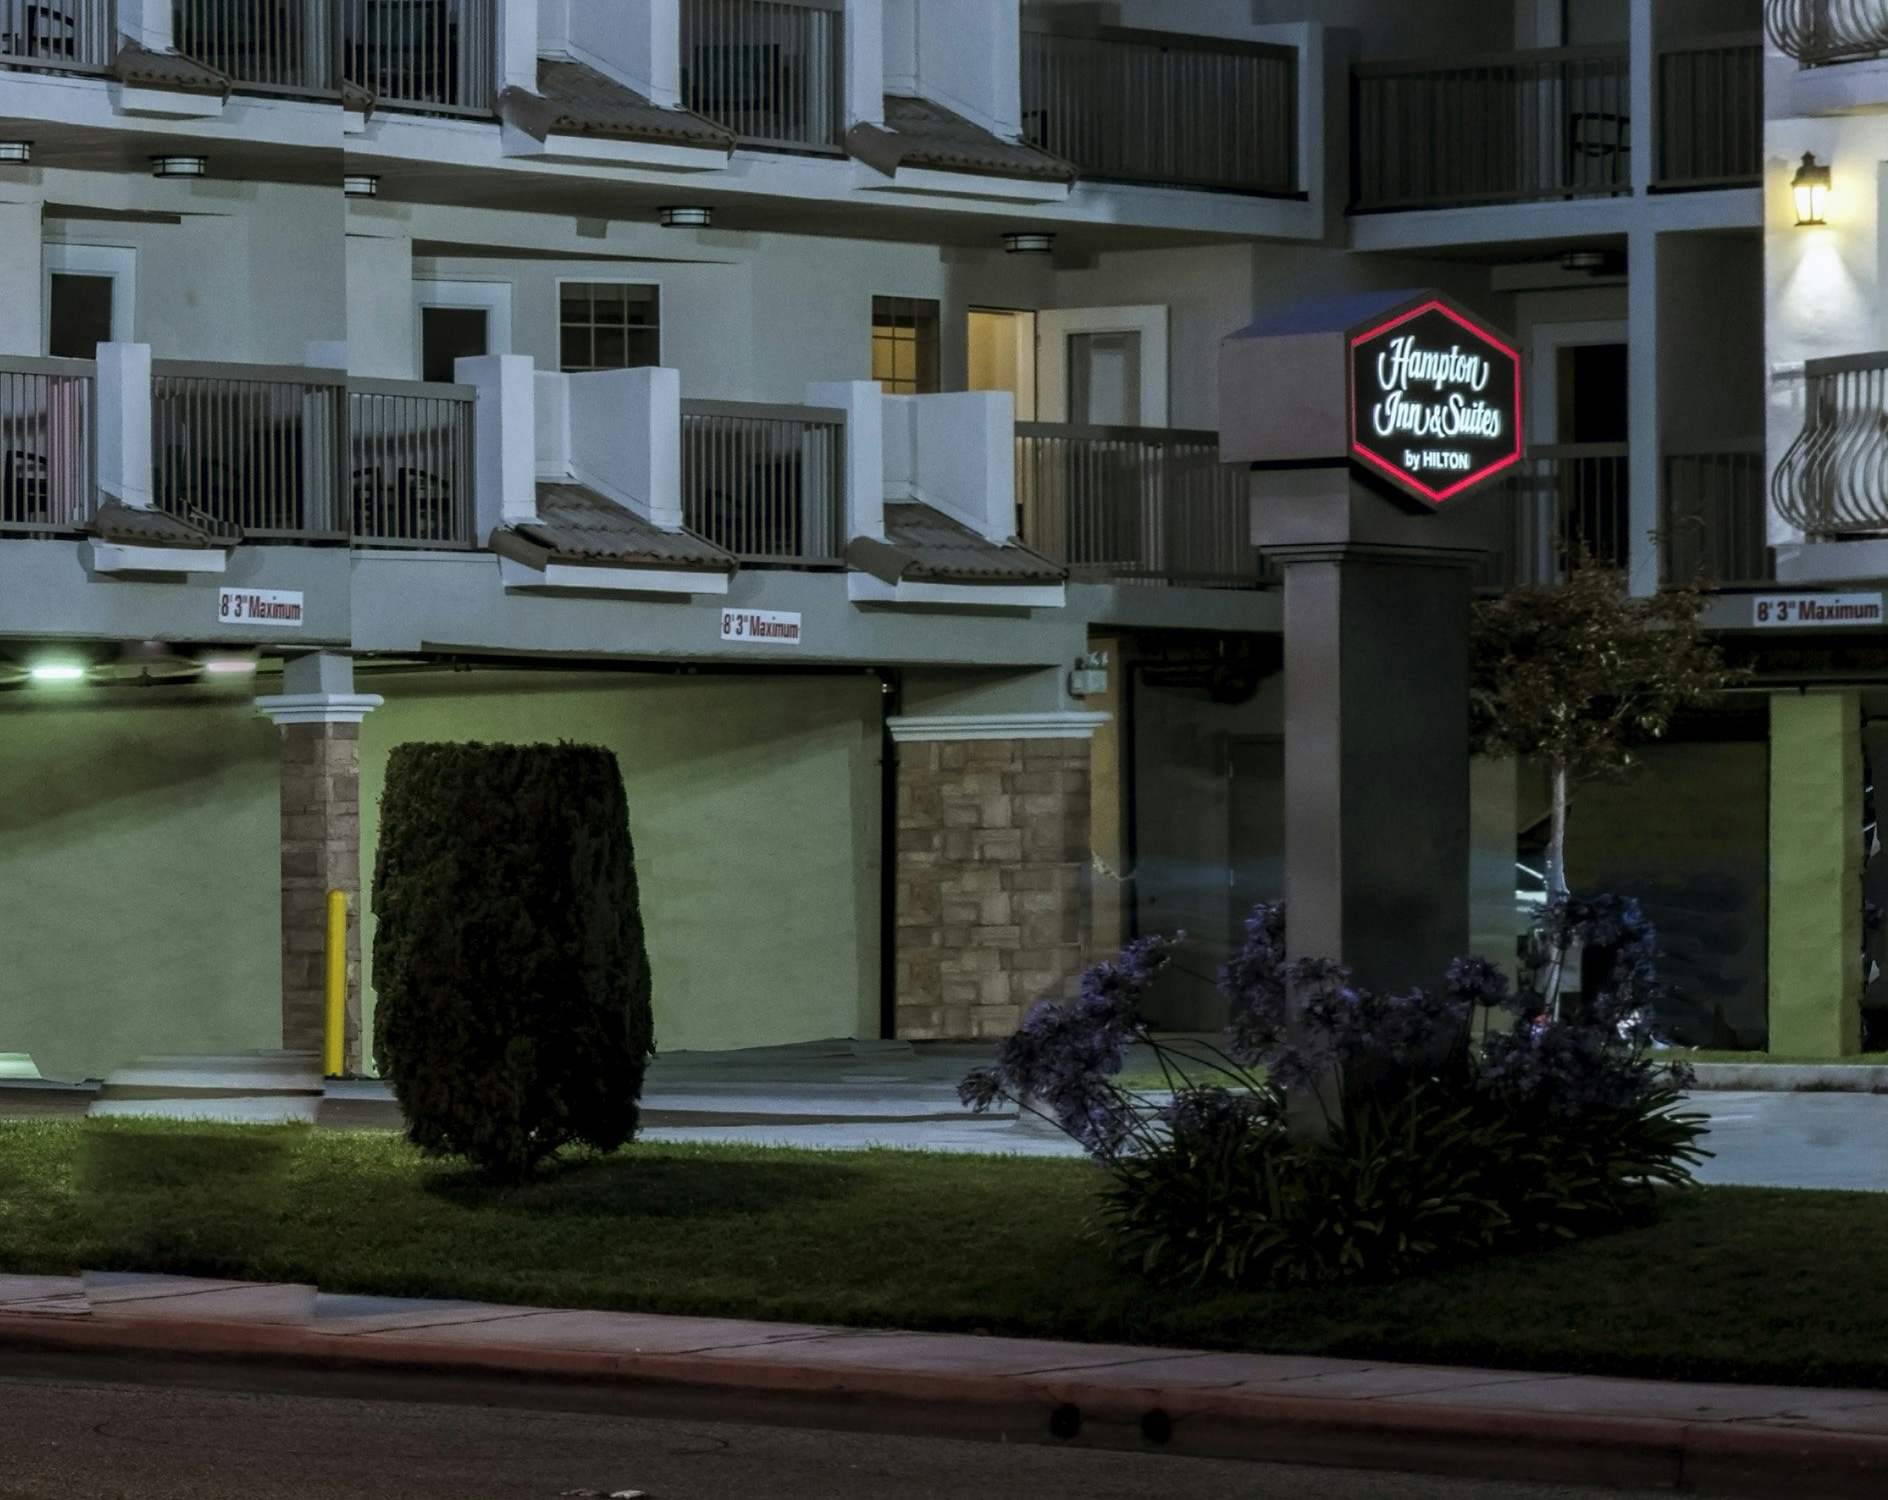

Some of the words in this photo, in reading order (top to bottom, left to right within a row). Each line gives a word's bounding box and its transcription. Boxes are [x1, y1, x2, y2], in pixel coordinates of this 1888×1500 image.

[1378, 335, 1490, 391] Hampton
[1374, 390, 1429, 436] Inn
[1430, 404, 1446, 438] &
[1443, 393, 1501, 438] Suites
[1404, 449, 1420, 471] by
[1423, 450, 1470, 470] HILTON
[249, 595, 301, 620] Maximum
[1798, 599, 1879, 620] Maximum
[749, 615, 798, 639] Maximum
